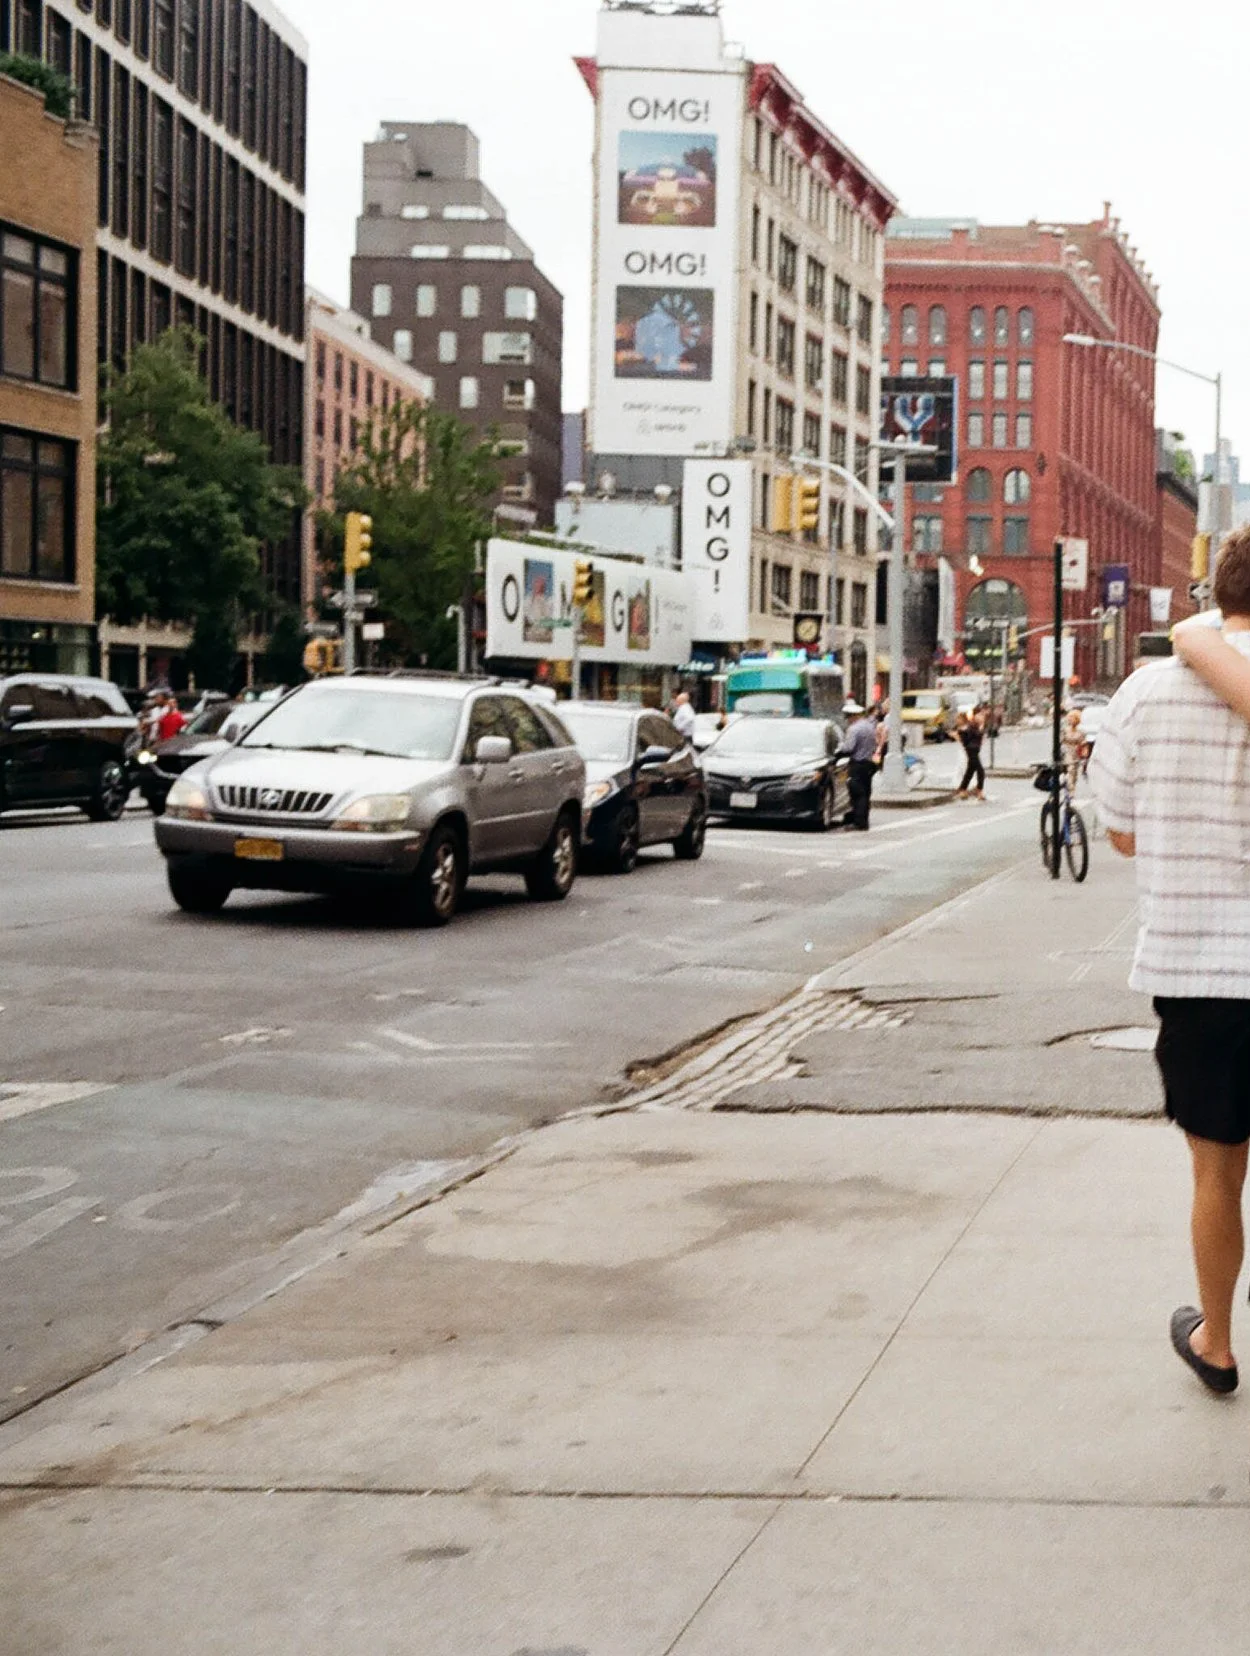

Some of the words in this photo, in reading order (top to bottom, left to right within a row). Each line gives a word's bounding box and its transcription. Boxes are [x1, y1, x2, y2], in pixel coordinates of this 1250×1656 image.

[627, 96, 710, 123] OMG!
[624, 251, 706, 276] OMG!
[706, 472, 730, 593] OMG!
